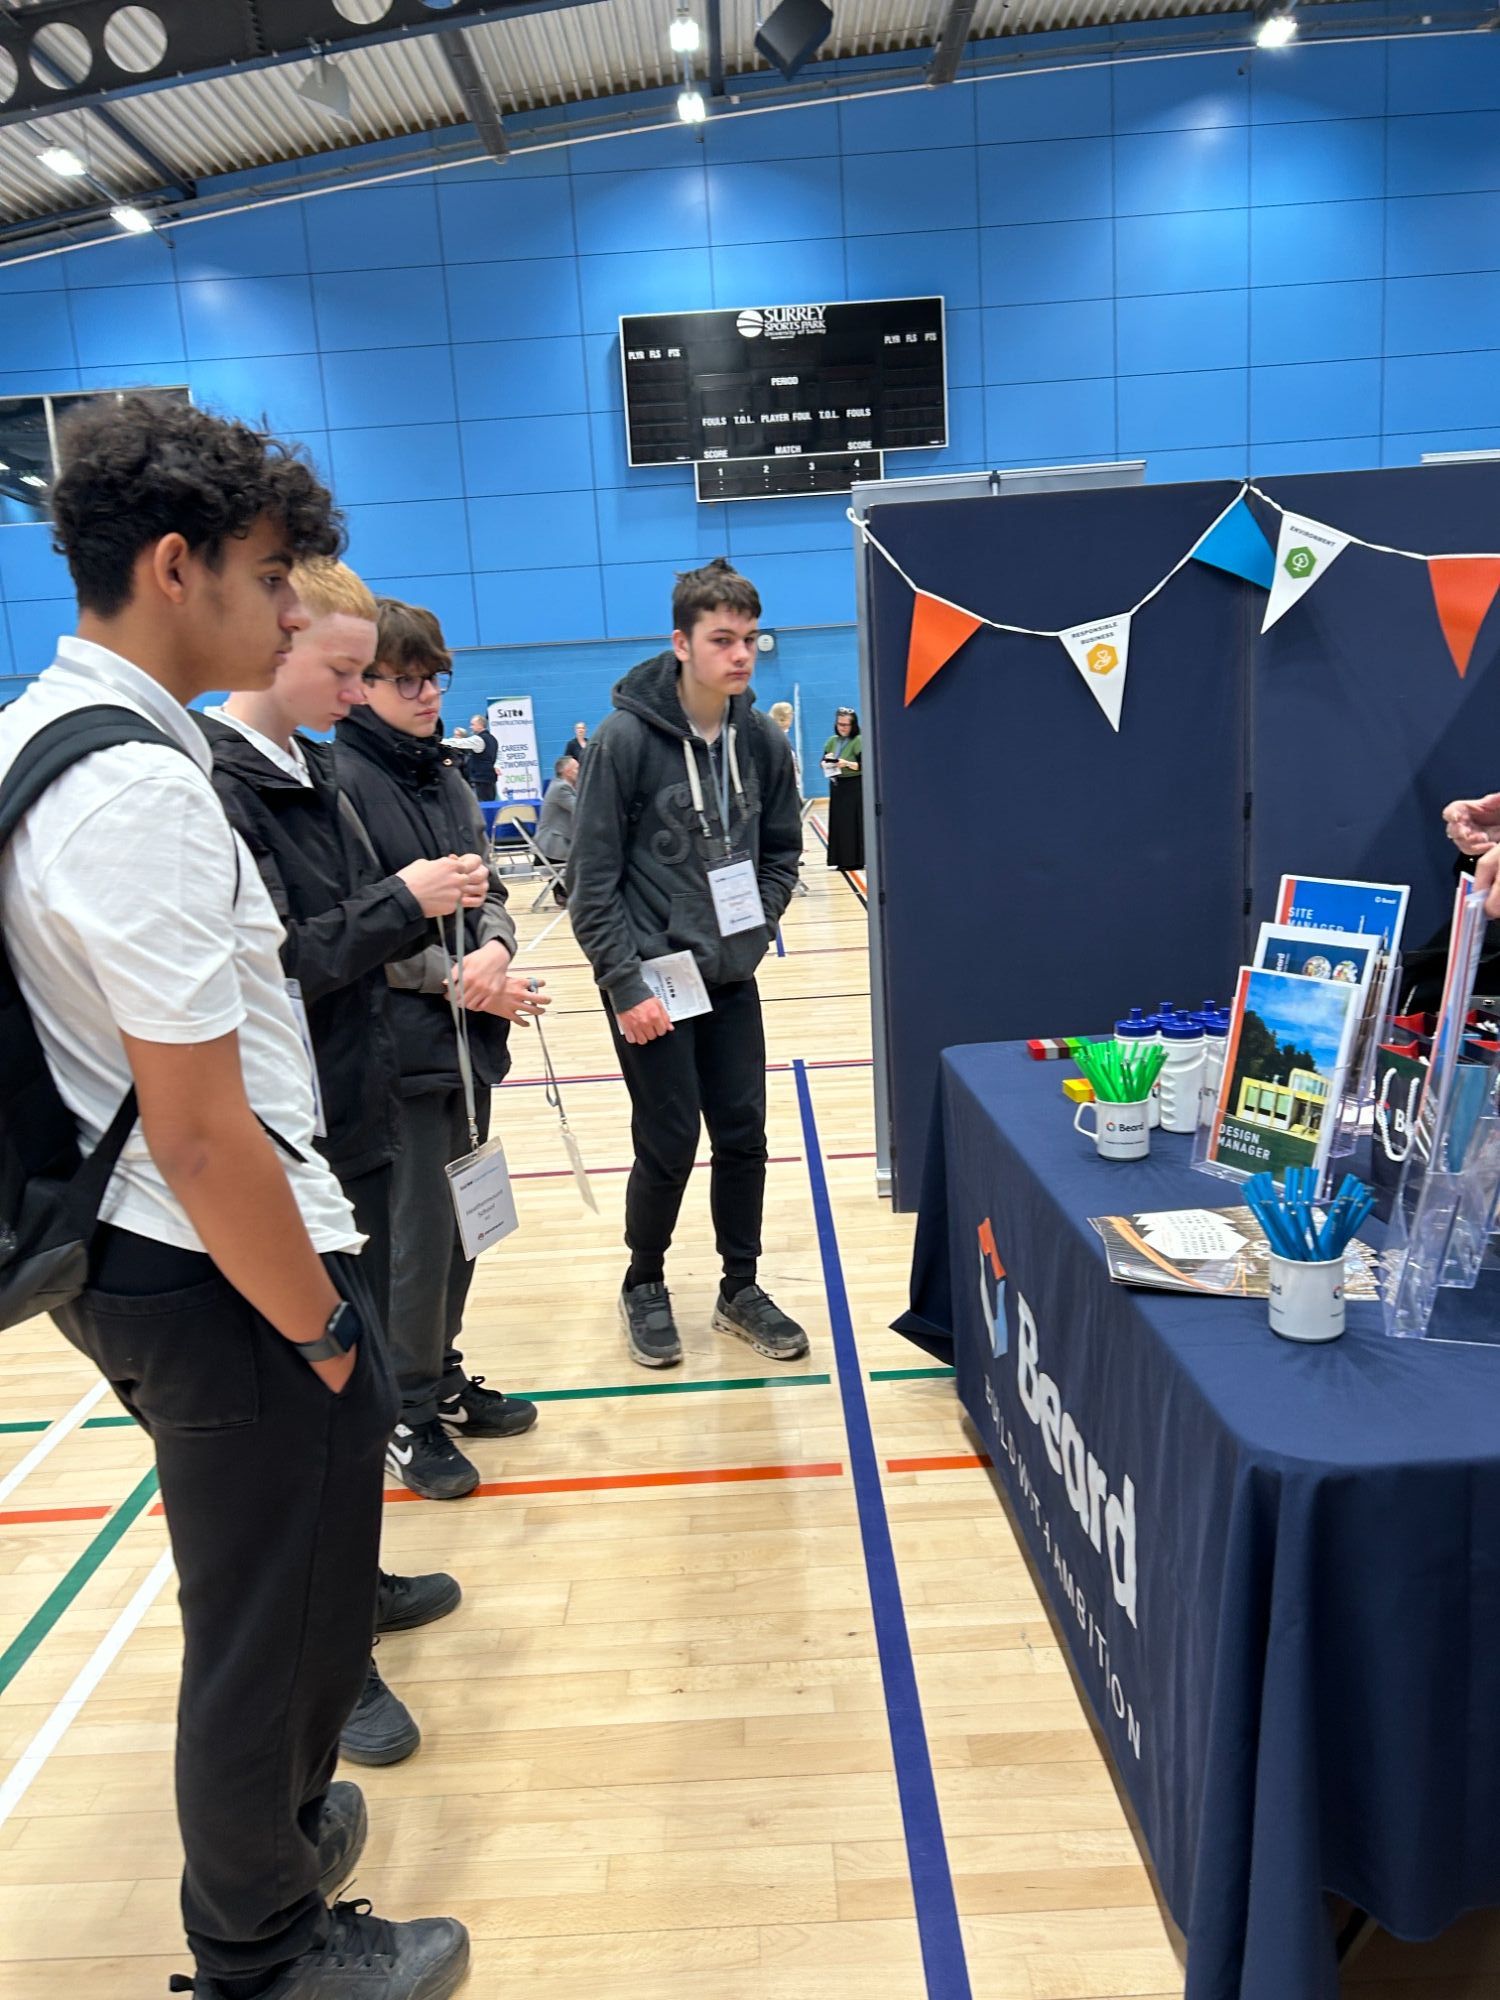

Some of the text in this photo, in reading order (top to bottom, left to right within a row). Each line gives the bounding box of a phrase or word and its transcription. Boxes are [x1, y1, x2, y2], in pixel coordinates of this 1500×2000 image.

[764, 306, 826, 322] SURREY
[764, 320, 826, 332] SPORTS PARK
[884, 332, 938, 344] PLYR FLS PTS
[628, 348, 681, 360] PLYR FLS PTS
[771, 376, 799, 386] PERIOD
[702, 416, 727, 426] FOULS
[760, 413, 790, 423] PLAYER
[792, 412, 812, 421] FOUL
[846, 408, 871, 418] FOULS
[774, 445, 802, 455] MATCH
[847, 440, 872, 450] SCORE
[703, 449, 728, 459] SCORE
[718, 458, 861, 476] 1 2 3 4
[1289, 525, 1336, 547] ENVIRONMENT
[1071, 621, 1118, 638] RESPONSIBLE
[1080, 631, 1114, 645] BUSINESS
[501, 744, 528, 752] CAREERS
[506, 752, 526, 760] SPEED
[504, 774, 525, 783] ZONE
[1288, 907, 1314, 920] SITE
[1119, 1121, 1144, 1132] Beard
[1218, 1123, 1260, 1145] DESIGN
[1217, 1135, 1271, 1161] MANAGER
[1018, 1291, 1138, 1629] Beard
[985, 1373, 1016, 1465] BUILD
[1053, 1542, 1141, 1760] AMBITION
